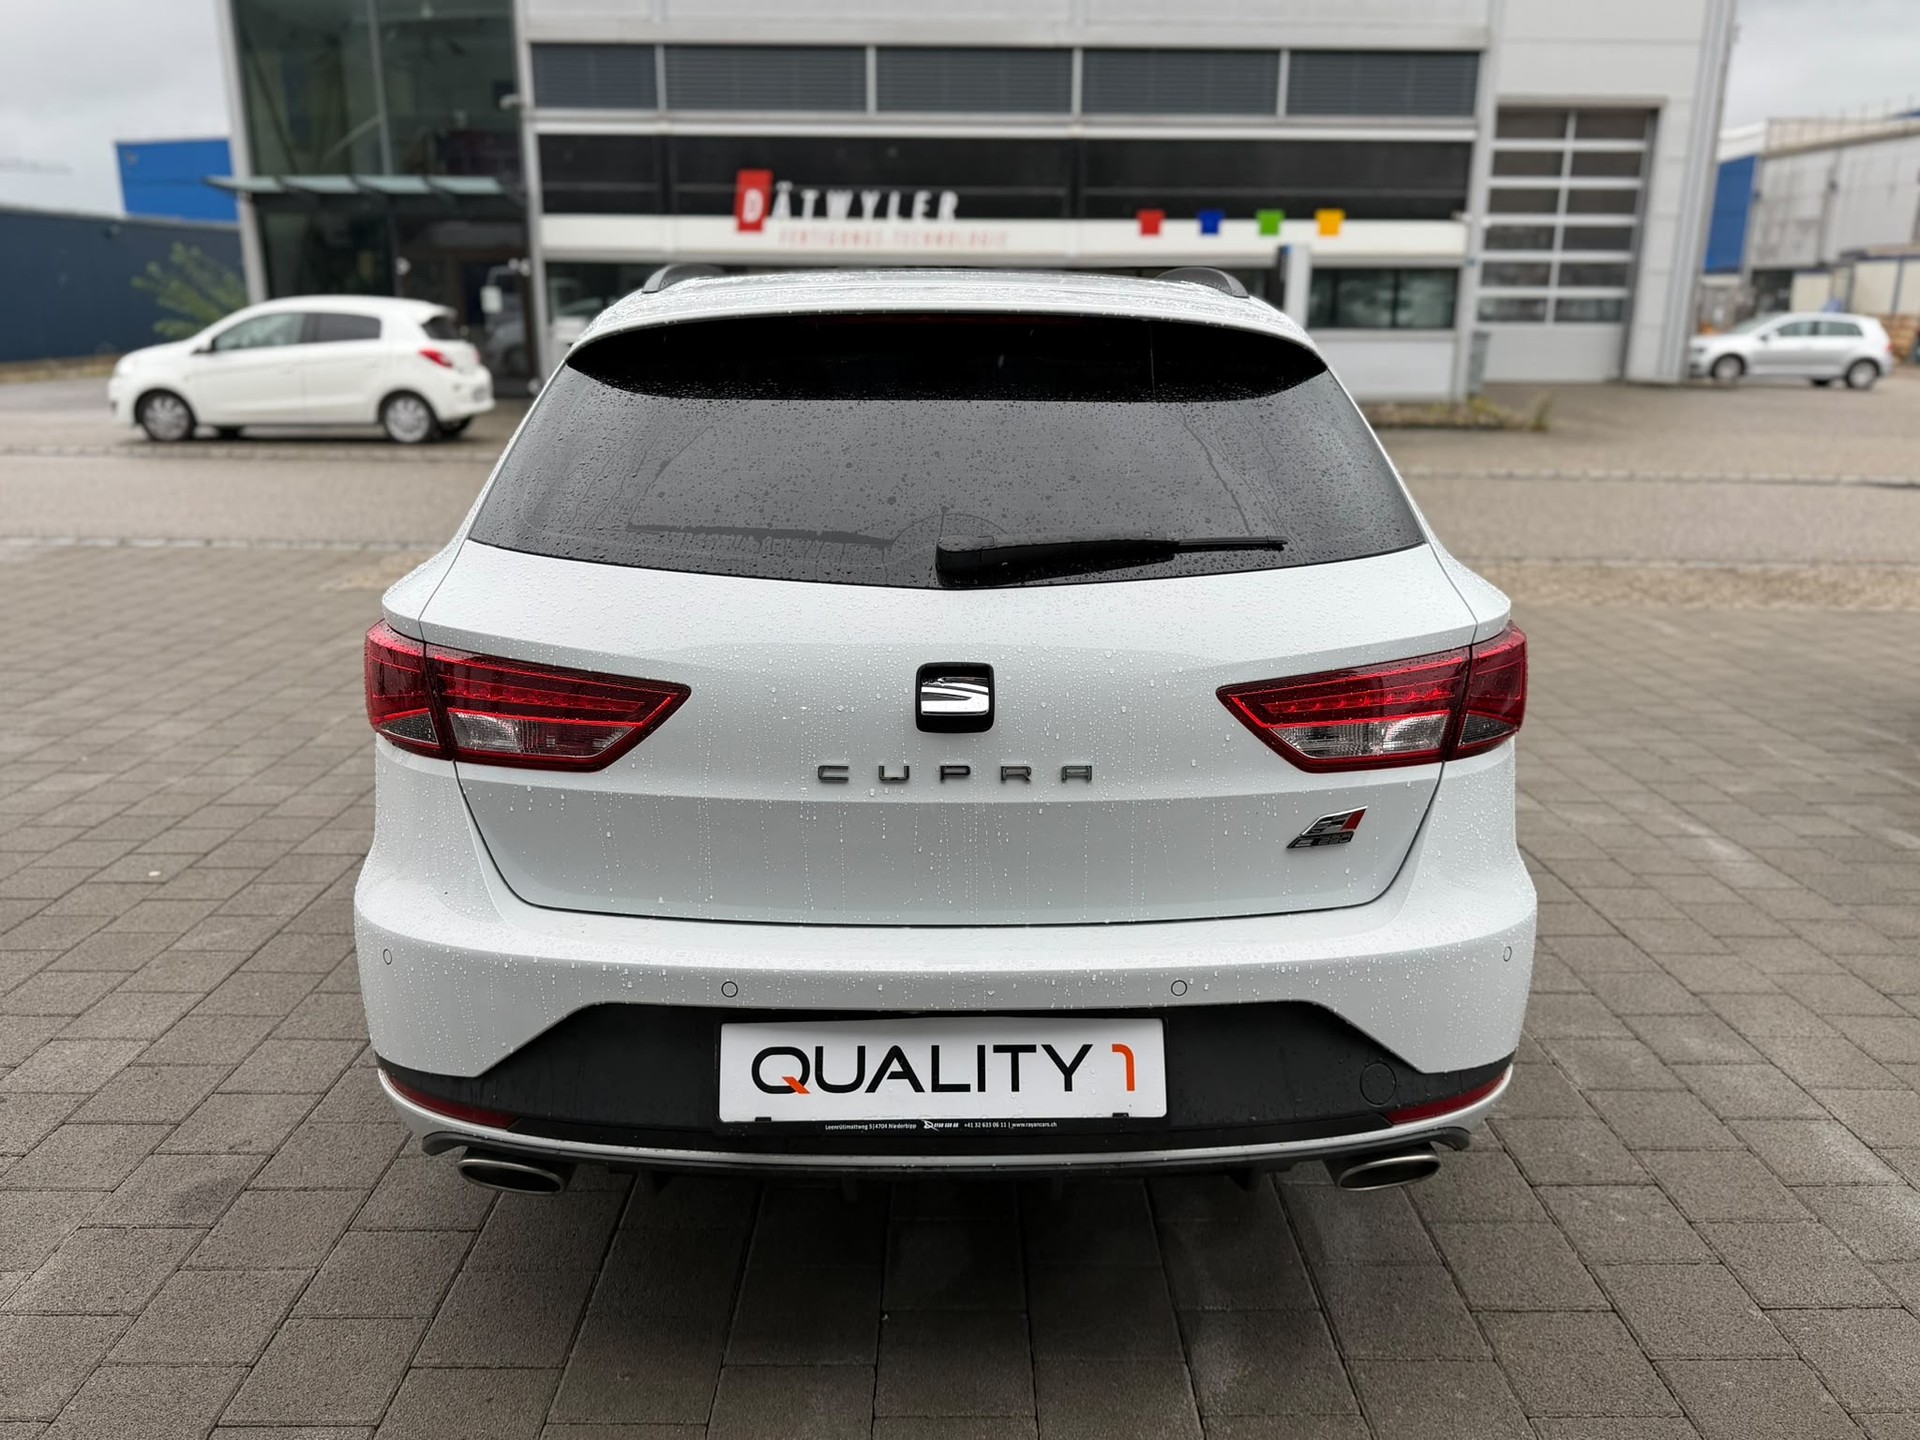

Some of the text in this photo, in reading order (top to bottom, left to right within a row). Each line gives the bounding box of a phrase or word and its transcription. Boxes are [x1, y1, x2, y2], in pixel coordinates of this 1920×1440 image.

[742, 181, 958, 224] DÄTWYLER
[817, 765, 1093, 783] CUPRA
[751, 1043, 1136, 1095] QUALITY 1
[888, 1122, 917, 1130] Niederbipp
